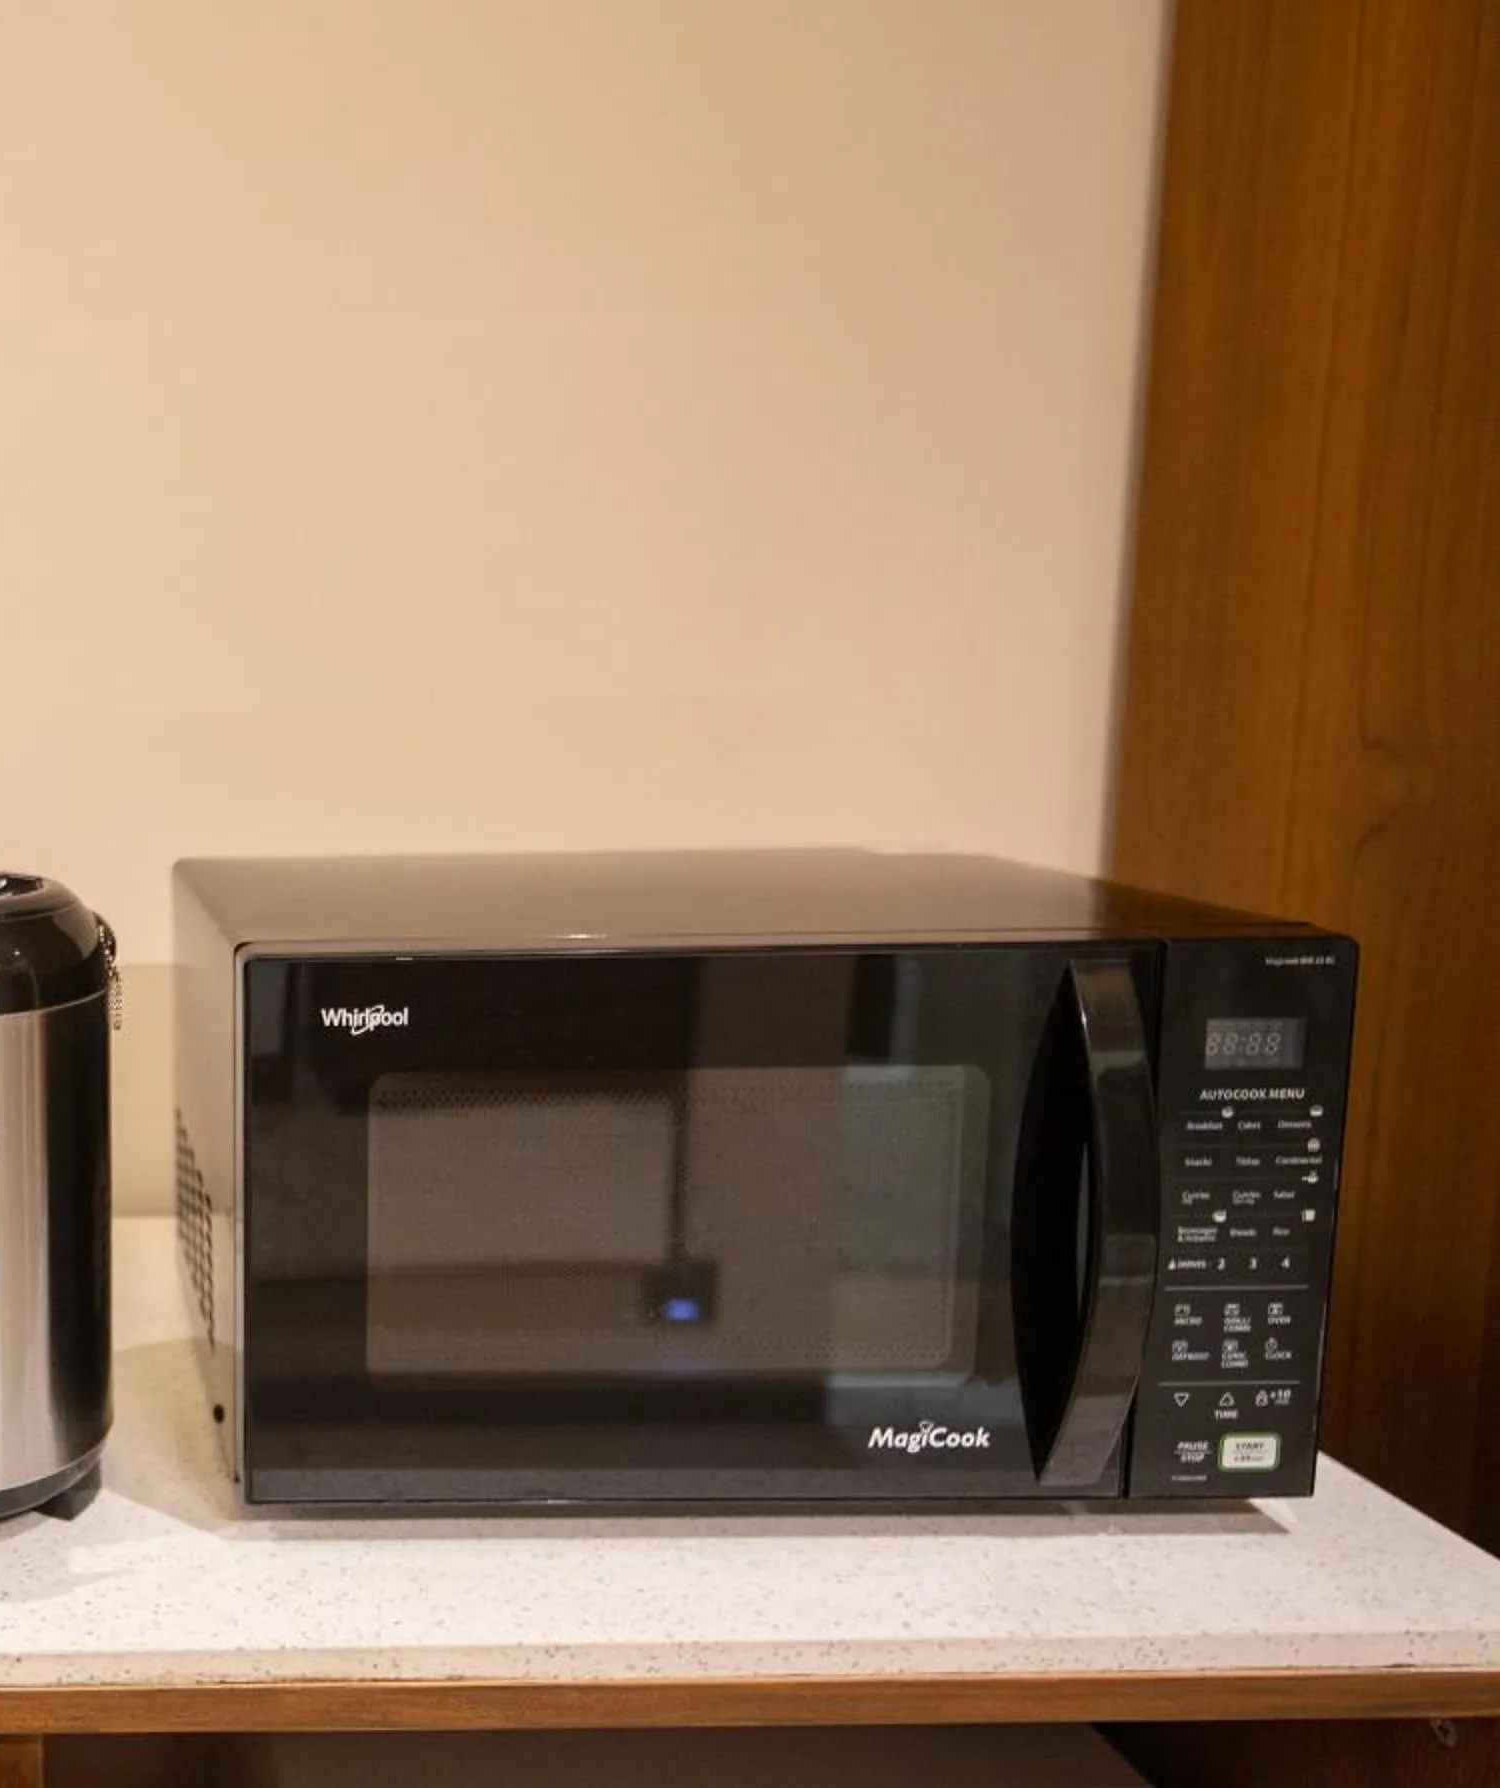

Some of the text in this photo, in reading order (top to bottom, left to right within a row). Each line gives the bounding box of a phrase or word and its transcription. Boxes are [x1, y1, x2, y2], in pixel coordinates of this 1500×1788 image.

[321, 1004, 409, 1035] Whirlpool
[1200, 1088, 1305, 1100] AUTOCOOK MENU
[1217, 1257, 1226, 1270] 2
[1249, 1257, 1258, 1269] 3
[1281, 1256, 1291, 1269] 4
[1214, 1409, 1239, 1420] TIME
[867, 1420, 991, 1453] MagiCook
[1177, 1440, 1209, 1450] PAUSE
[1180, 1452, 1205, 1463] STOP
